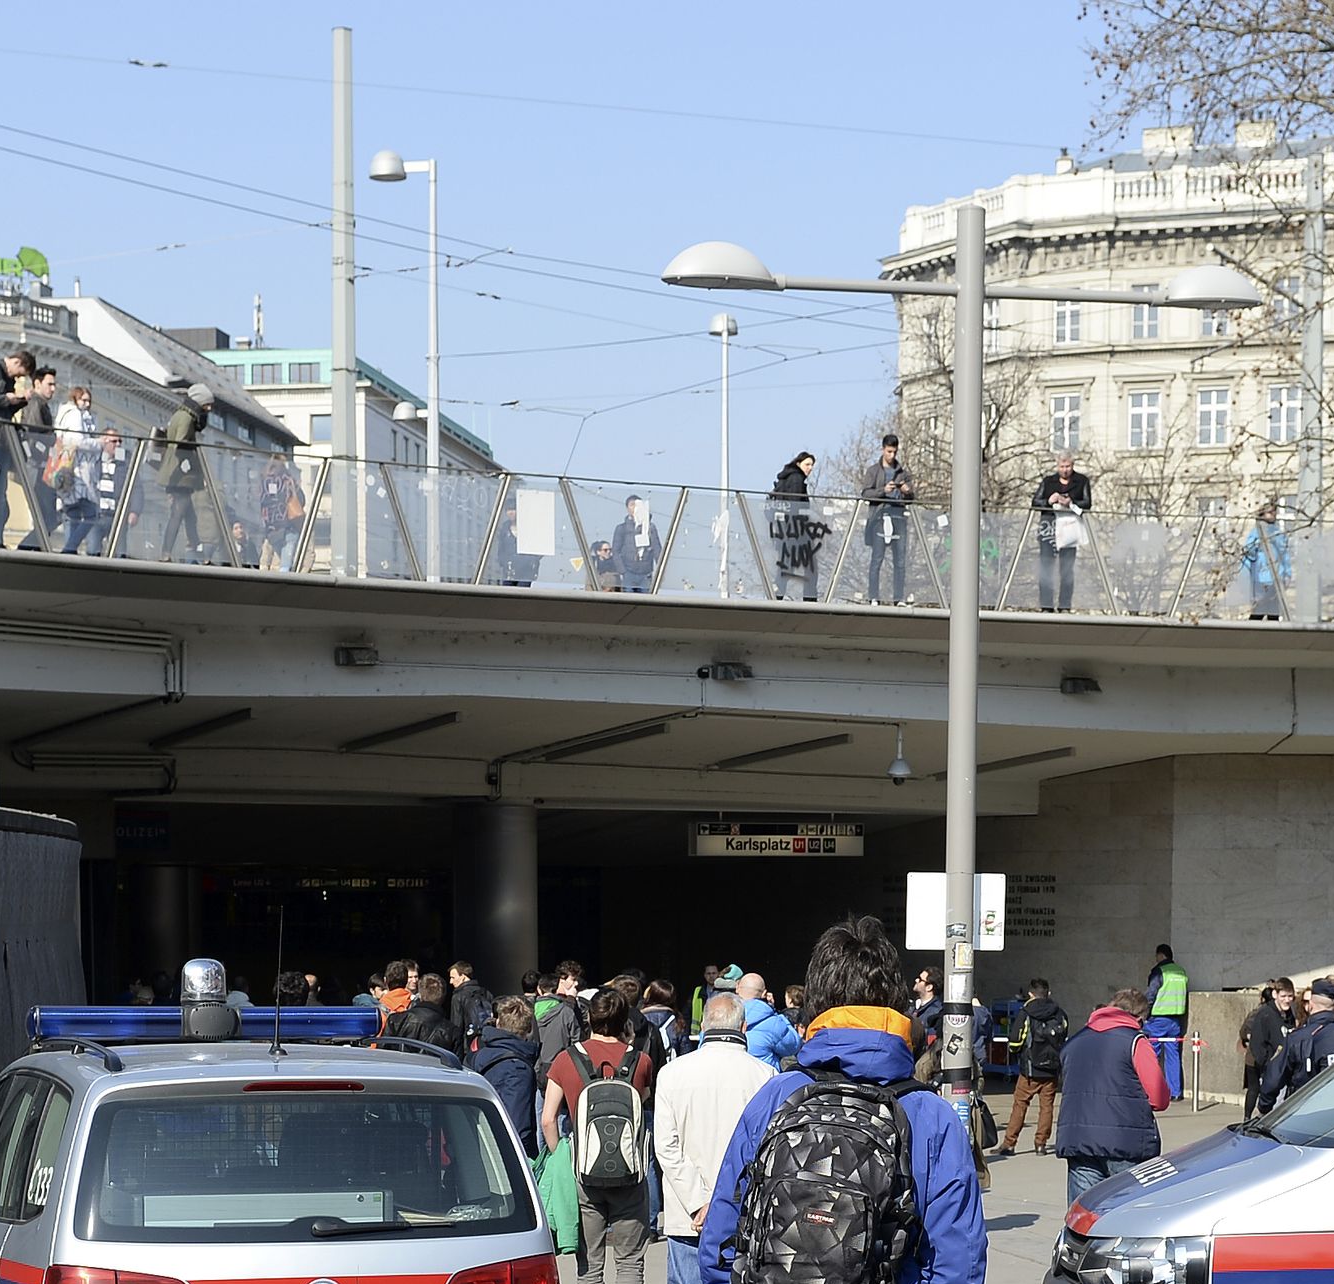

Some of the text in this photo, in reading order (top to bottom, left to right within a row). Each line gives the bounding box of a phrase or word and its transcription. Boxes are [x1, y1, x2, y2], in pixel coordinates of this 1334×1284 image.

[725, 837, 836, 853] Karlsplatz U1 U2 U4
[35, 1166, 54, 1206] 133
